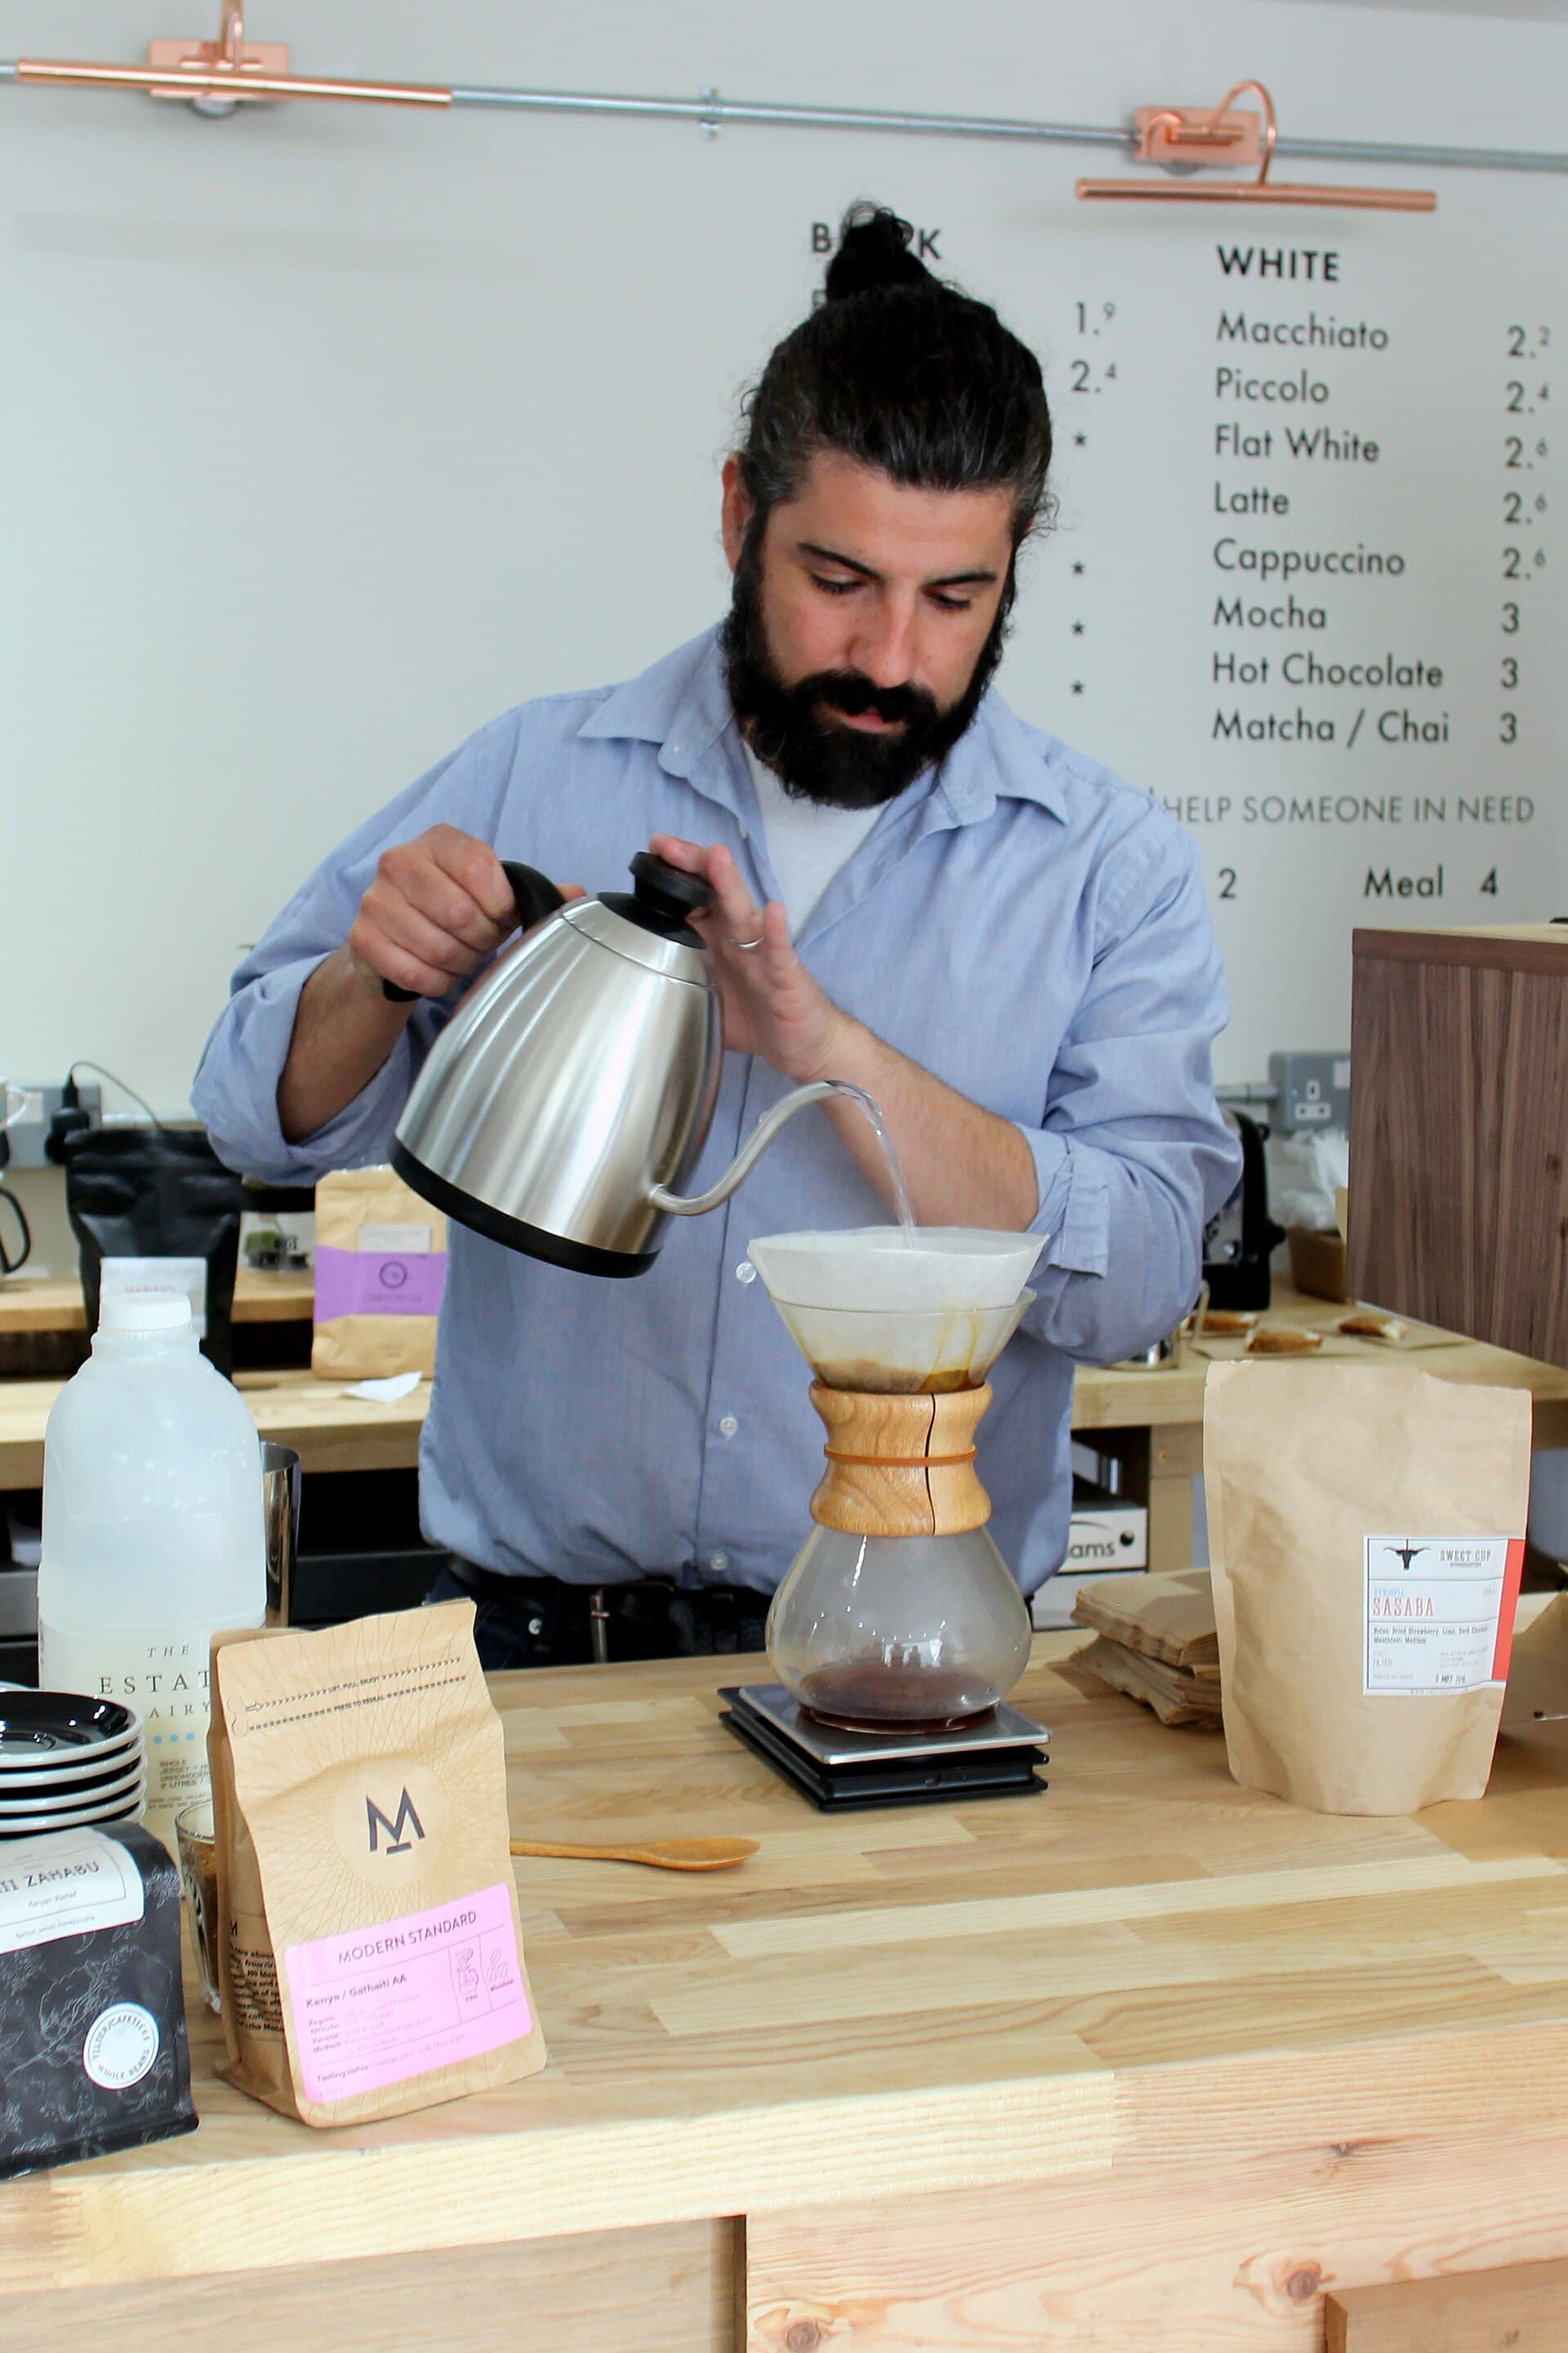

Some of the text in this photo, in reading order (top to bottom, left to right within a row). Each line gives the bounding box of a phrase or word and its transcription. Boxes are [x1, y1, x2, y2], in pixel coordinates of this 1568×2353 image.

[1217, 246, 1339, 281] WHITE
[1216, 311, 1389, 350] Macchiato
[1071, 360, 1117, 394] 2.4
[1216, 368, 1549, 414] Piccolo 2.4
[1215, 423, 1272, 457] Flat
[1285, 426, 1380, 463] White
[1214, 481, 1290, 515] Latte
[1214, 537, 1405, 581] Cappuccino
[1213, 595, 1520, 634] Mocha 3
[1213, 652, 1519, 689] Hot Chocolate 3
[1212, 708, 1517, 748] Matcha / Chai 3
[1164, 795, 1535, 822] HELP SOMEONE IN NEED
[1218, 867, 1236, 898] 2
[1364, 863, 1498, 898] Meal 4
[1070, 1542, 1116, 1558] ams
[1440, 1549, 1491, 1562] SWEET CUP
[1373, 1598, 1434, 1616] SASABA
[148, 1644, 190, 1658] THE
[99, 1670, 211, 1695] ESTAT
[149, 1701, 211, 1718] AIRY
[23, 1861, 100, 1887] ZAHABU
[338, 1911, 477, 1964] MODERN STANDARD
[392, 1972, 408, 1985] AA
